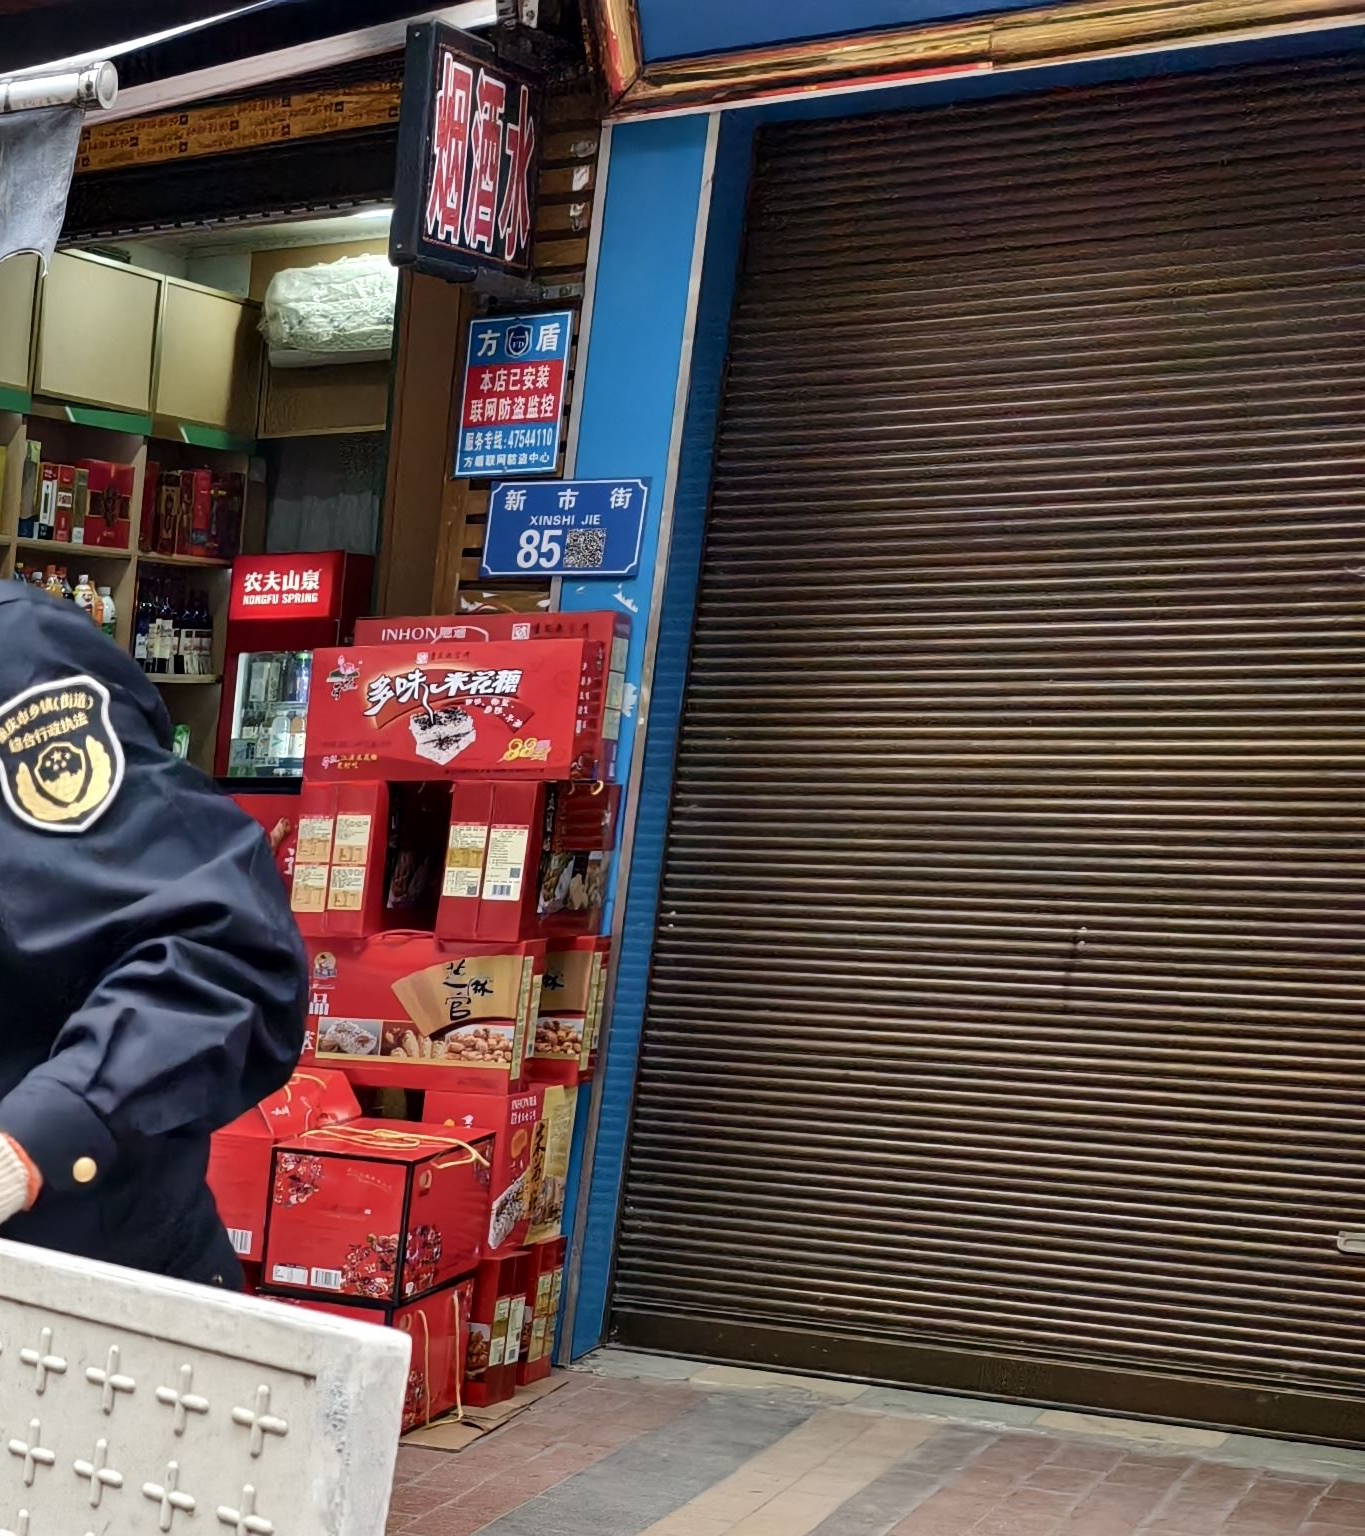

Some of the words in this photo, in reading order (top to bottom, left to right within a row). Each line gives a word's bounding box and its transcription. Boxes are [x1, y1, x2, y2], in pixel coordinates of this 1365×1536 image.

[426, 51, 535, 262] 烟酒水
[479, 364, 551, 393] 本店已安装
[469, 393, 555, 423] 联网防盗监控
[463, 451, 550, 468] 方盾联网防盗中心
[504, 487, 632, 512] 新市街
[529, 514, 575, 526] XINSHI
[581, 514, 601, 525] JIE
[516, 528, 563, 569] 85
[243, 568, 322, 593] 农夫山泉
[243, 593, 279, 606] NONGFU
[282, 592, 319, 605] SPRING
[381, 627, 438, 641] INHON
